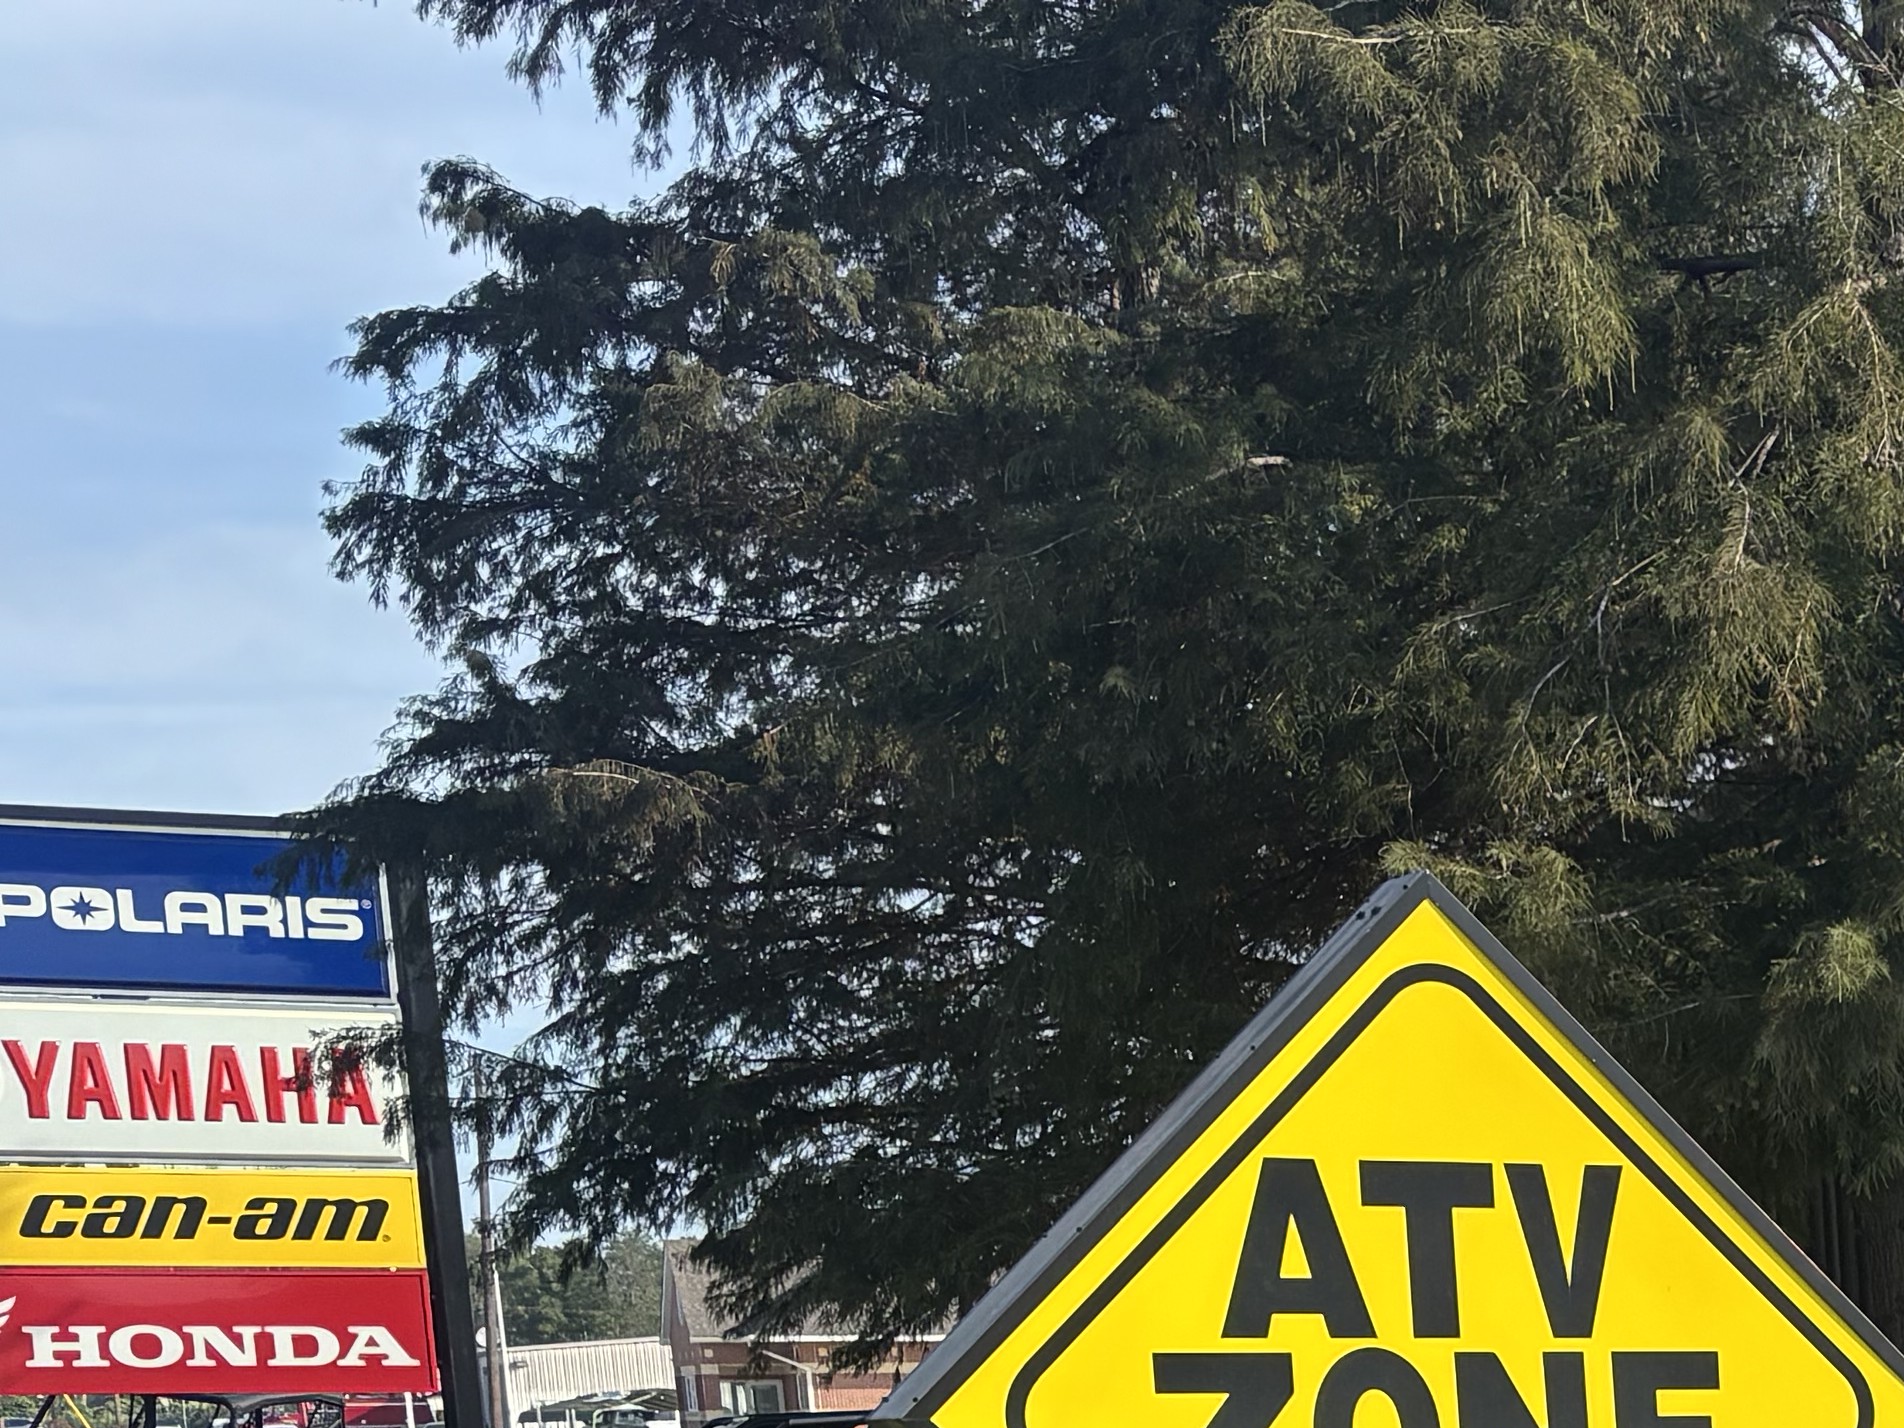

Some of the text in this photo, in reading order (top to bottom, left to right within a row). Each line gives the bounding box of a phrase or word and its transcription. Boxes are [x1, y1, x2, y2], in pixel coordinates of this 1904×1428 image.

[0, 883, 364, 941] POLARIS
[2, 1039, 382, 1126] YAMAHA
[19, 1194, 390, 1241] can-am
[1221, 1157, 1621, 1339] ATV
[21, 1325, 421, 1368] HONDA
